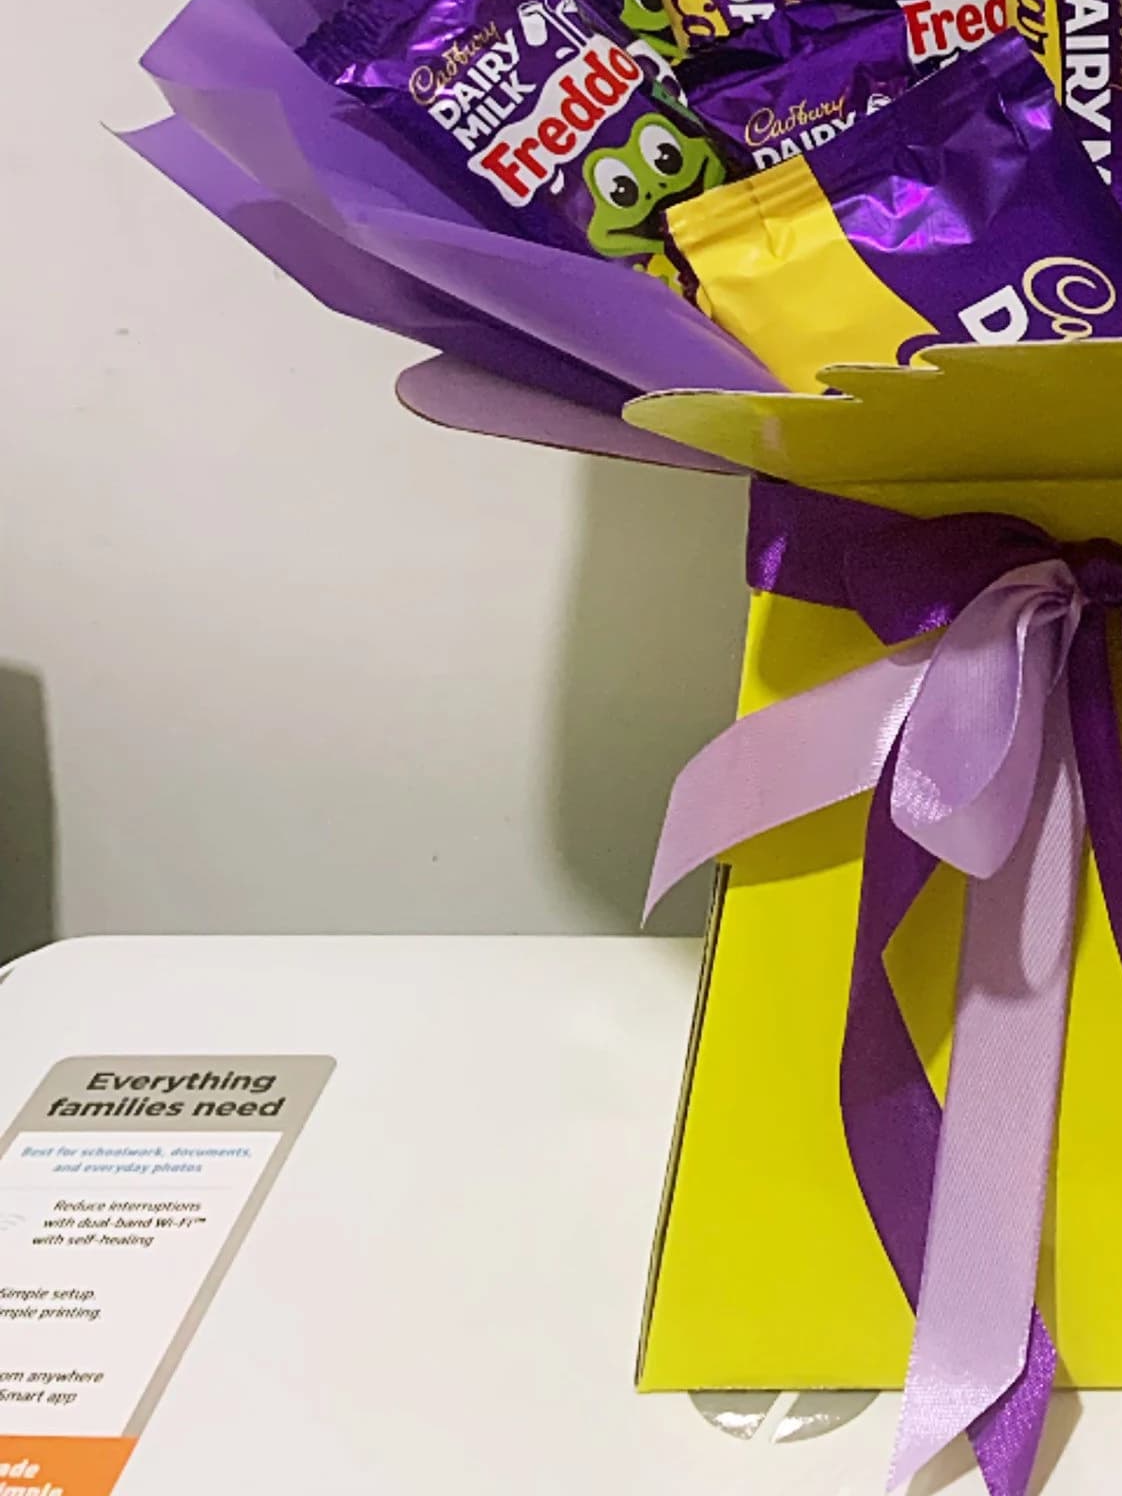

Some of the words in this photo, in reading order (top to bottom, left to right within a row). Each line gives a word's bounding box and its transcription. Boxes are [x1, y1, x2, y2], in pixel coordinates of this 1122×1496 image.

[408, 20, 500, 104] Cadbury
[428, 28, 522, 131] DAIRY
[454, 69, 537, 152] MILK
[480, 44, 642, 200] Freddo
[743, 96, 846, 148] Cadbury
[86, 1071, 277, 1093] Everything
[46, 1097, 184, 1118] families
[192, 1097, 285, 1118] need
[57, 1146, 78, 1157] for
[170, 1146, 253, 1159] documents,
[53, 1162, 83, 1173] and
[83, 1162, 150, 1174] everyday
[151, 1162, 203, 1174] photos
[53, 1200, 106, 1211] Reduce
[109, 1200, 202, 1213] interruptions
[43, 1217, 75, 1228] with
[77, 1217, 153, 1229] dual-band
[32, 1234, 64, 1246] with
[67, 1234, 155, 1248] self-healing
[26, 1370, 104, 1384] anywhere
[47, 1392, 78, 1405] app
